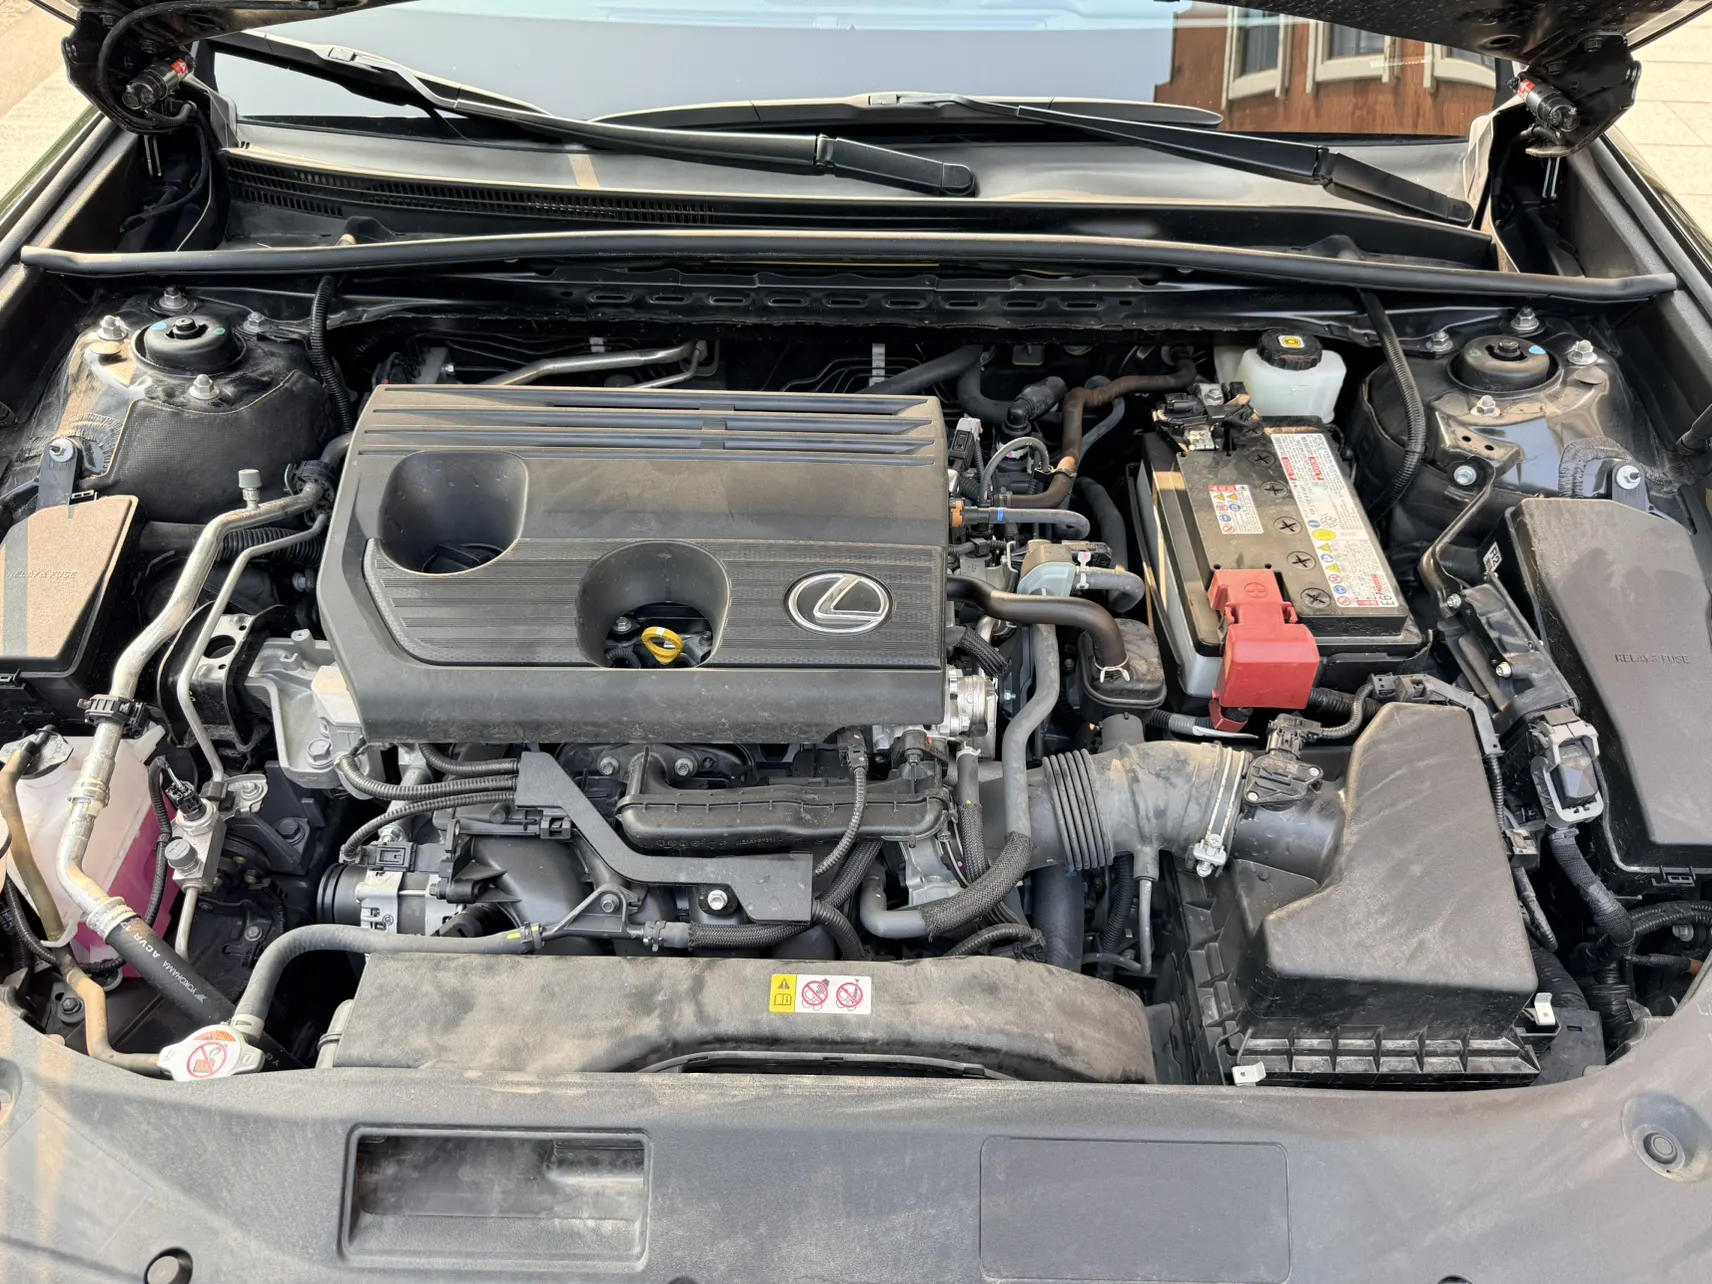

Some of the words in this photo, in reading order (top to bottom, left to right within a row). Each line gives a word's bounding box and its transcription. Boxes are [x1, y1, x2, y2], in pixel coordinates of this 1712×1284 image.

[1614, 653, 1649, 663] RELAY
[1660, 653, 1690, 664] FUSE
[162, 960, 197, 995] YOKOHAMA
